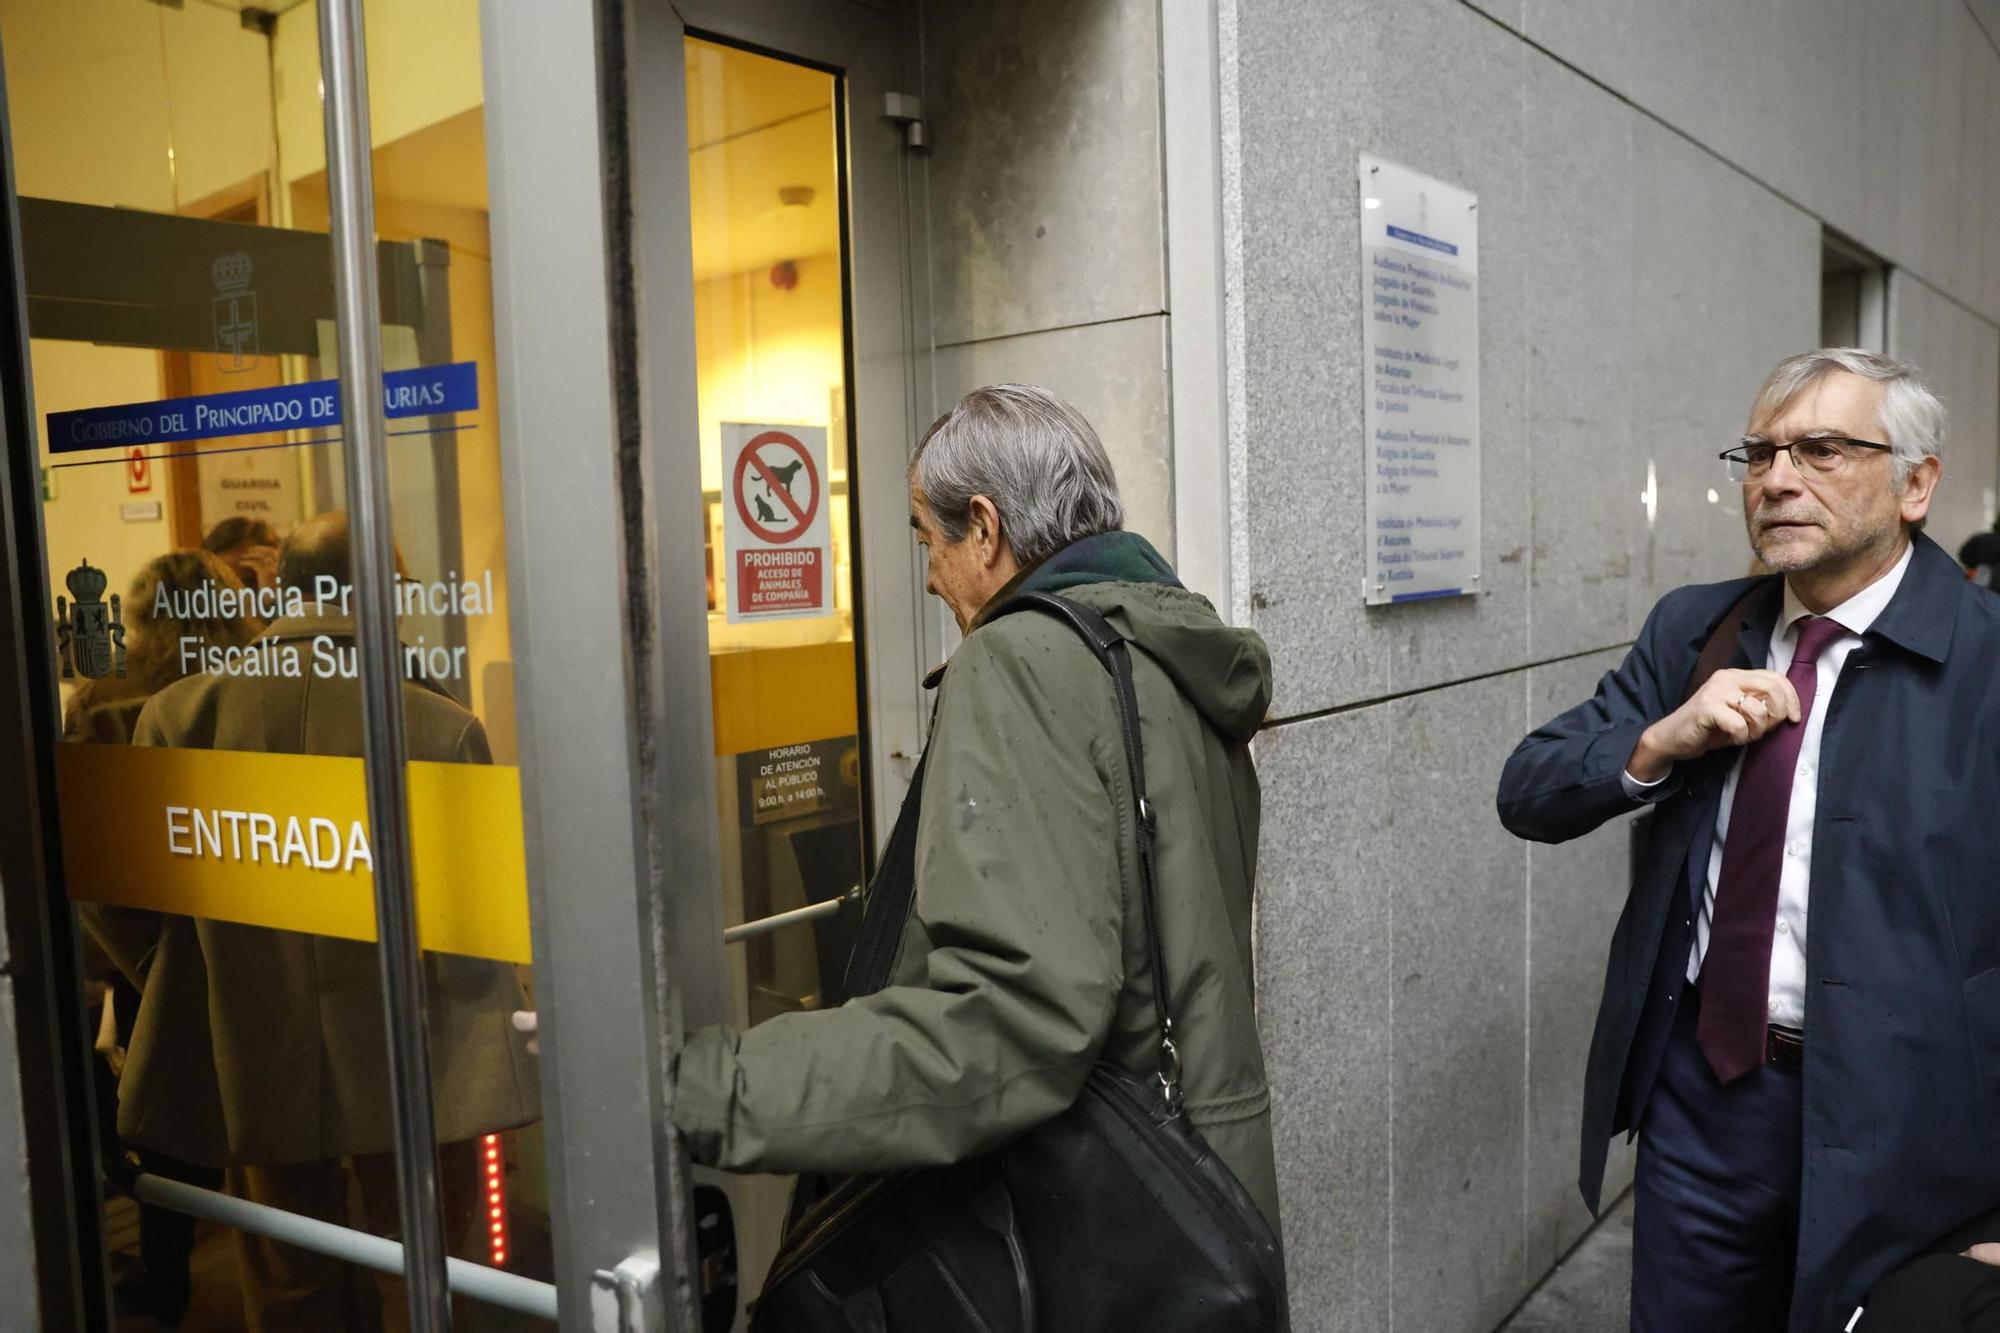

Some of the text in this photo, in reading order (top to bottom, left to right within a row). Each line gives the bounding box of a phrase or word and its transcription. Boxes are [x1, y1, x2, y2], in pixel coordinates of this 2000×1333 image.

[160, 413, 189, 435] DEL
[196, 399, 303, 431] PRINCIPADO
[311, 395, 335, 418] DE
[386, 382, 445, 409] URIAS
[744, 551, 816, 568] PROHIBIDO
[758, 567, 802, 580] ACCESO DE
[153, 570, 494, 619] Audiencia Princial
[759, 579, 802, 591] ANIMALES
[751, 588, 809, 603] DE COMPAÑÍA
[179, 634, 467, 680] Fiscalía Surior
[768, 744, 812, 760] HORARIO
[760, 756, 821, 777] DE ATENCIÓN
[765, 770, 818, 790] AL PÚBLICO
[166, 806, 373, 872] ENTRADA
